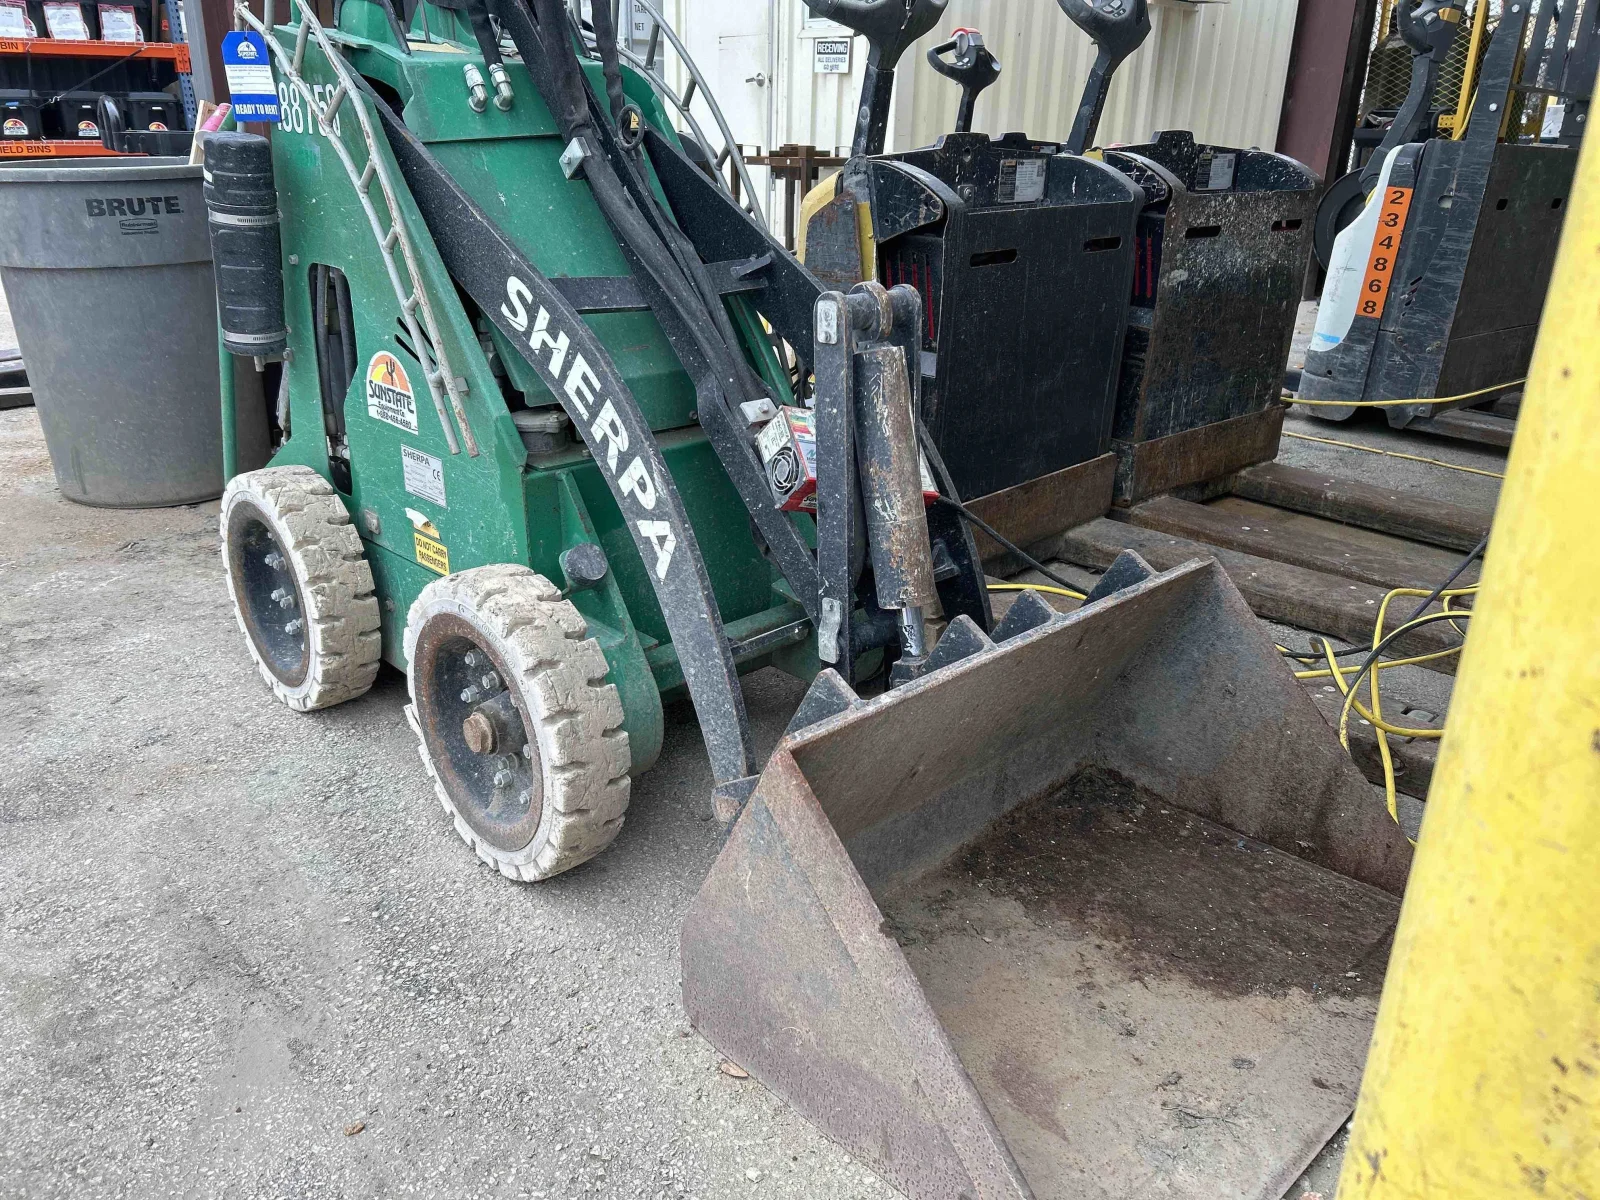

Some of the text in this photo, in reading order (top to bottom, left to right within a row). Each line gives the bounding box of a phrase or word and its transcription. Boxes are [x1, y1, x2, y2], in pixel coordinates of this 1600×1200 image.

[634, 22, 644, 31] NET
[1, 42, 19, 50] BIN
[817, 42, 847, 54] RECEIVING
[234, 104, 278, 115] READY TO RENT
[26, 145, 52, 153] BINS
[85, 196, 182, 217] BRUTE
[500, 275, 677, 586] SHERPA
[402, 448, 431, 468] SHERPA
[415, 536, 447, 560] DO NOT CARRY
[418, 550, 448, 573] PASSENGERS
